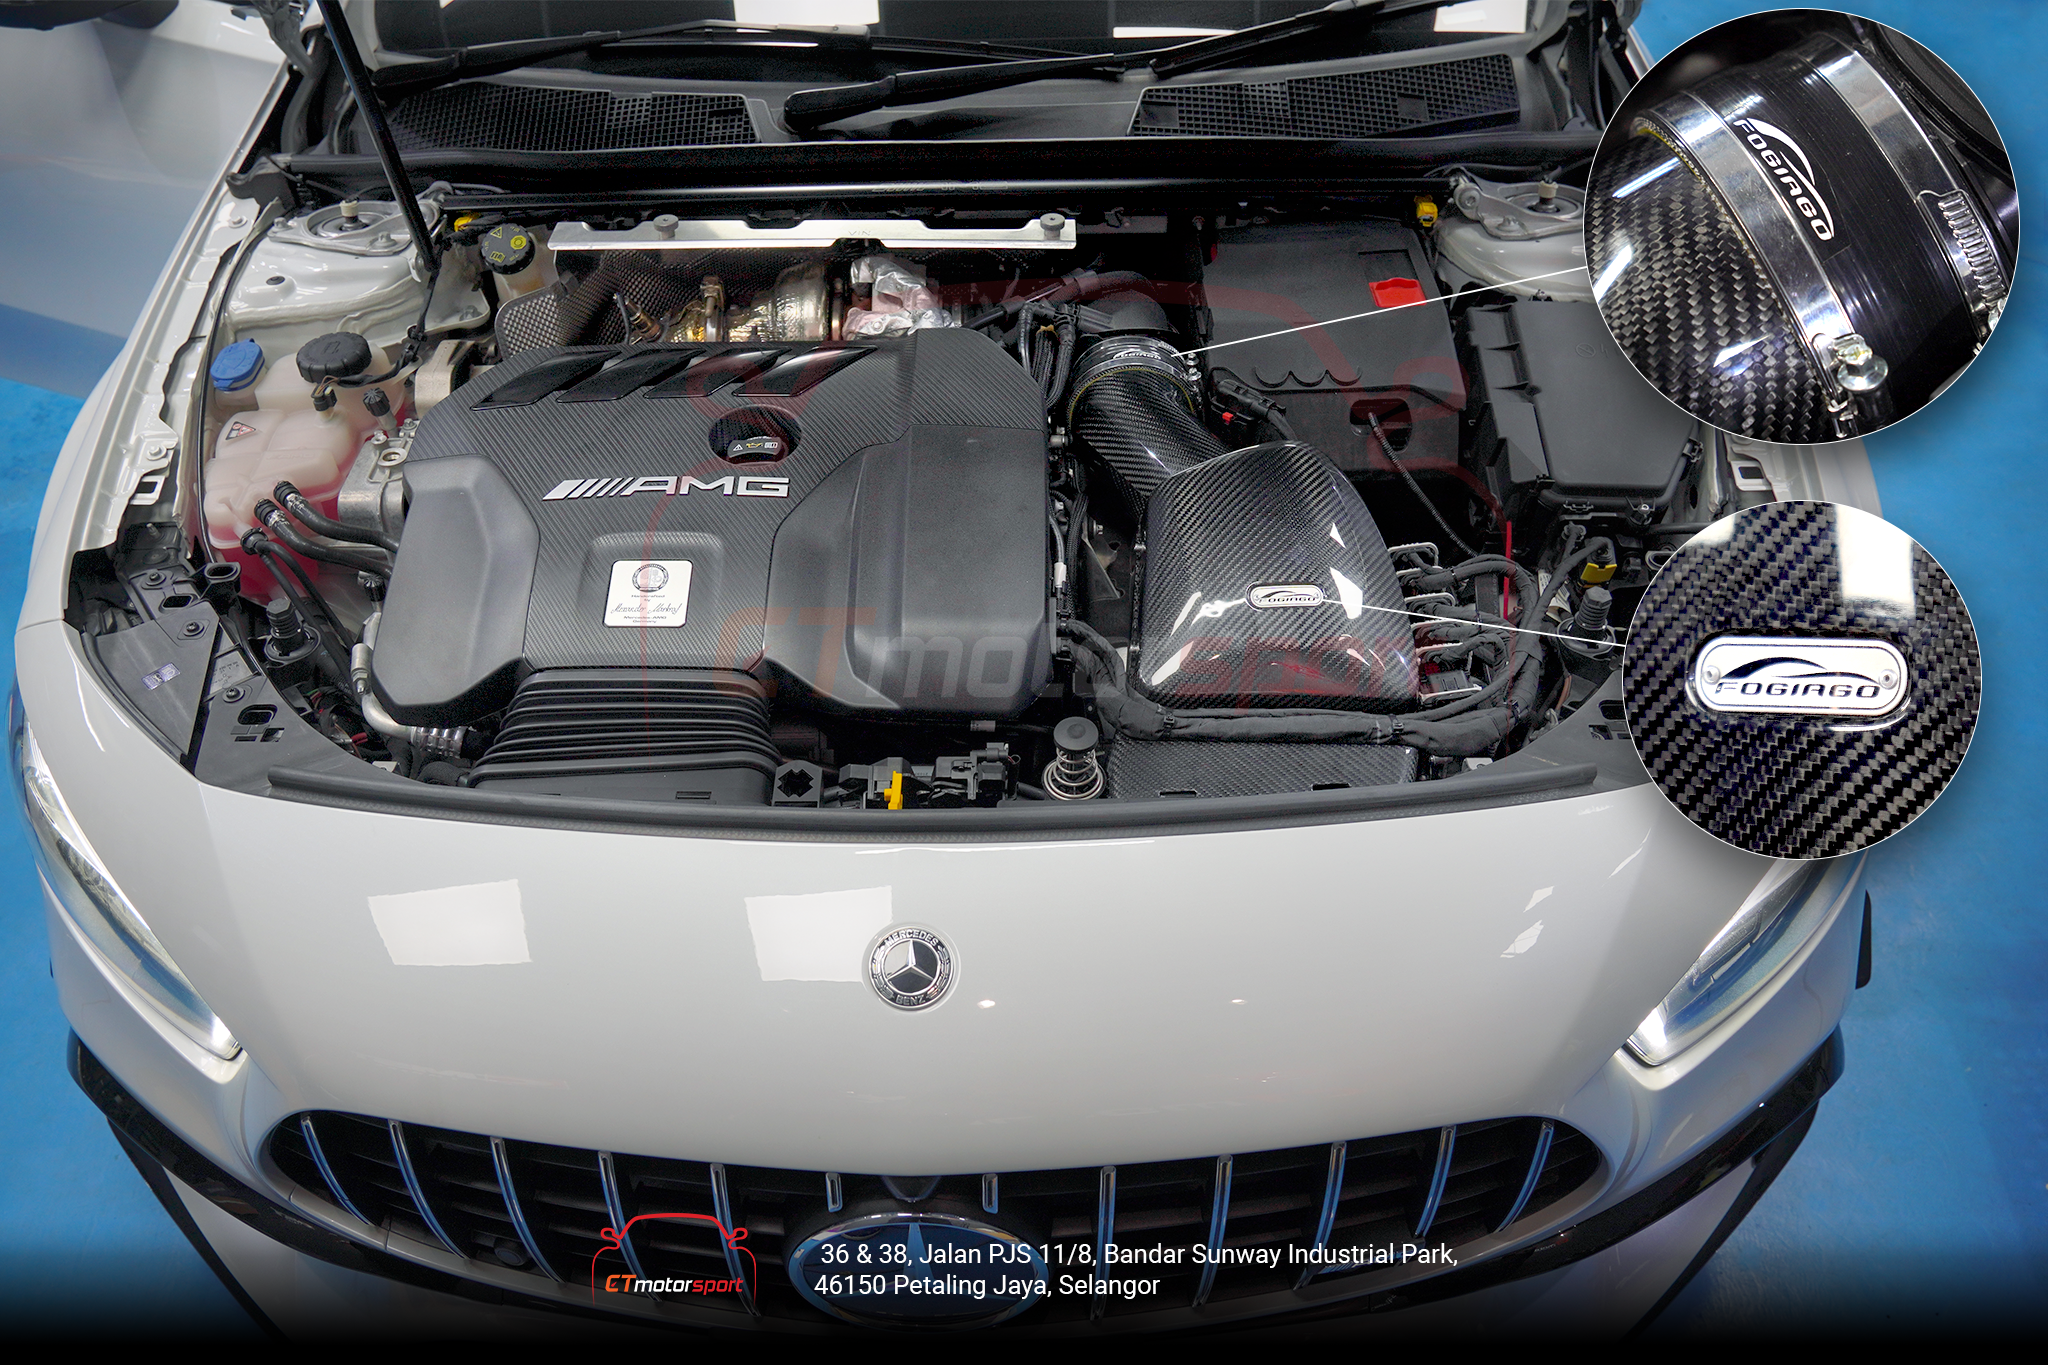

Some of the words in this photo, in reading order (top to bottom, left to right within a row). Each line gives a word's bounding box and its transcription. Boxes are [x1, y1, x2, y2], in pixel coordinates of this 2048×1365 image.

[620, 475, 790, 498] AMG
[884, 928, 939, 947] MERCEDES
[895, 994, 927, 1006] BENZ
